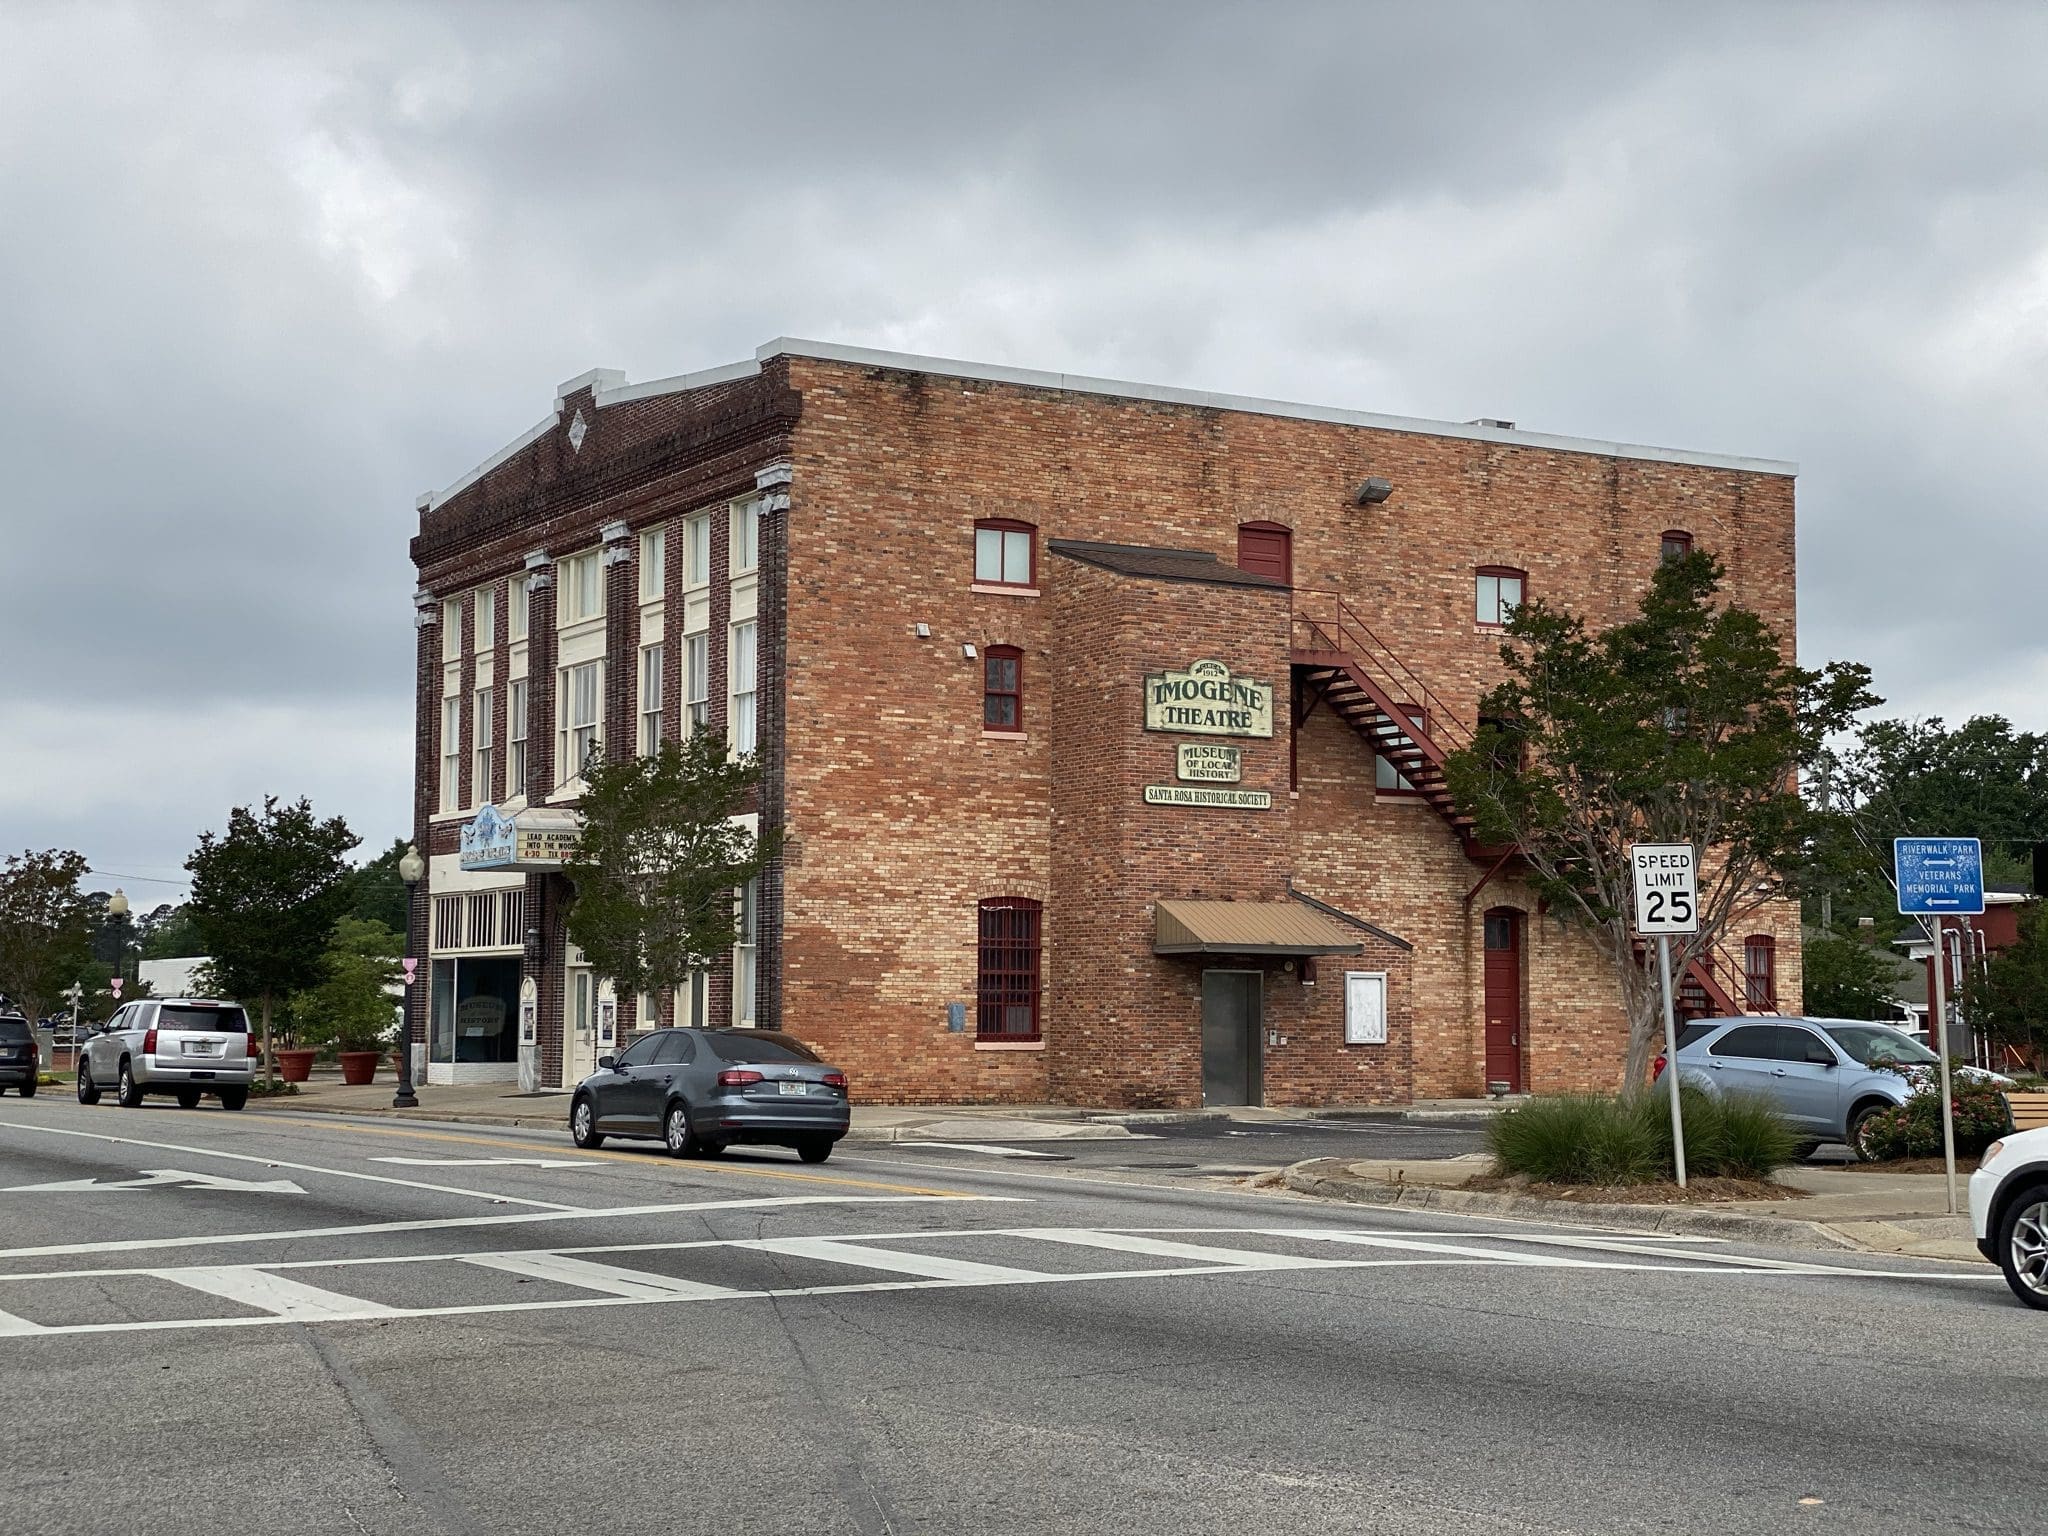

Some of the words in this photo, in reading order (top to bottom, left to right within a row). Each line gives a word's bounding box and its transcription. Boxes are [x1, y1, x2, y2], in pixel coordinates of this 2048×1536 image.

[1155, 680, 1264, 711] IMOGENE
[1165, 706, 1253, 728] THEATRE
[1183, 747, 1238, 760] MUSEUM
[1186, 760, 1199, 768] OF
[1202, 761, 1233, 770] LOCAL
[1189, 769, 1230, 779] HISTORY
[1148, 788, 1173, 801] SANTA
[1174, 790, 1192, 802] ROSA
[1194, 791, 1237, 805] HISTORICAL
[1238, 793, 1268, 806] SOCIETY
[527, 833, 543, 841] LEAD
[1902, 845, 1948, 855] RIVERWALK
[1952, 845, 1974, 855] PARK
[1638, 855, 1690, 868] SPEED
[1645, 873, 1685, 886] LIMIT
[1920, 870, 1962, 880] VETERANS
[1906, 884, 1949, 894] MEMORIAL
[1954, 884, 1975, 894] PARK
[1646, 890, 1692, 923] 25
